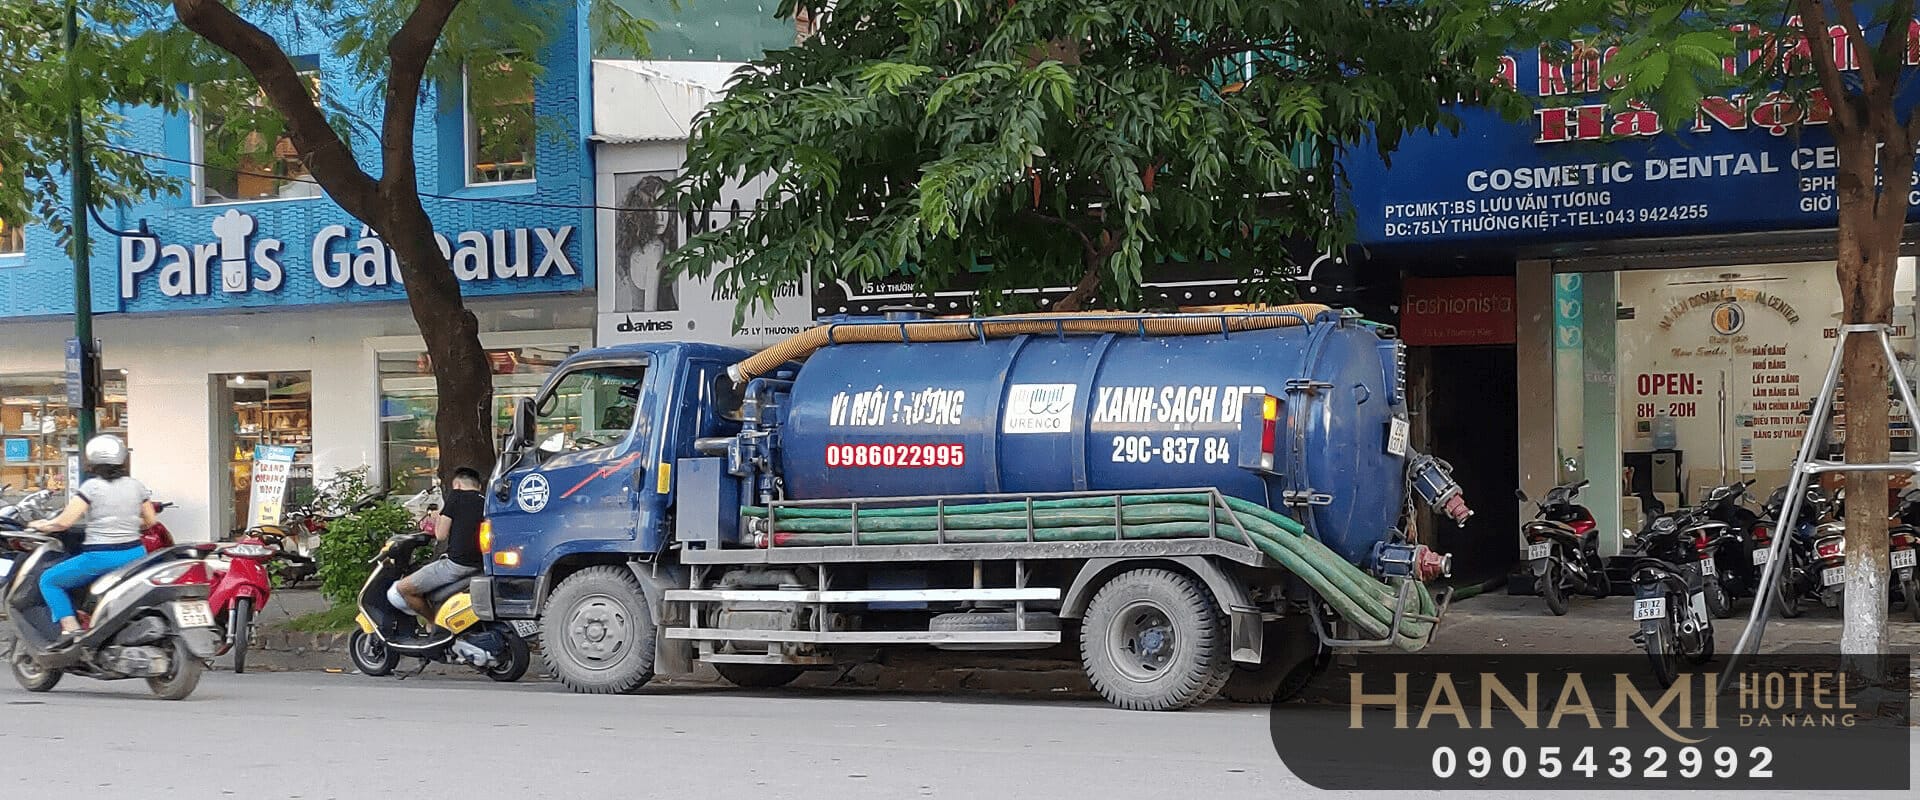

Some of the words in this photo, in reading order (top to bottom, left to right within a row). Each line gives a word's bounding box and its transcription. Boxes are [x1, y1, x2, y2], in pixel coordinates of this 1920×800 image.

[1534, 98, 1663, 143] Hà
[1467, 161, 1633, 192] COSMETIC
[1645, 152, 1779, 181] DENTAL
[1516, 193, 1547, 210] VĂN
[1639, 205, 1708, 222] 9424255
[120, 209, 284, 298] Paris
[313, 223, 577, 289] Gâaux
[887, 281, 914, 292] THƯỜN
[1406, 291, 1511, 315] Fashionista
[1767, 295, 1800, 325] CENTER
[617, 314, 673, 332] davines
[1637, 373, 1703, 396] OPEN:
[1094, 386, 1217, 431] XANH-SẠCH
[1221, 386, 1266, 431] ĐẸ
[1637, 403, 1655, 418] 8H
[1669, 402, 1696, 417] 20H
[1009, 417, 1060, 430] URENCO
[827, 445, 964, 466] 0986022995
